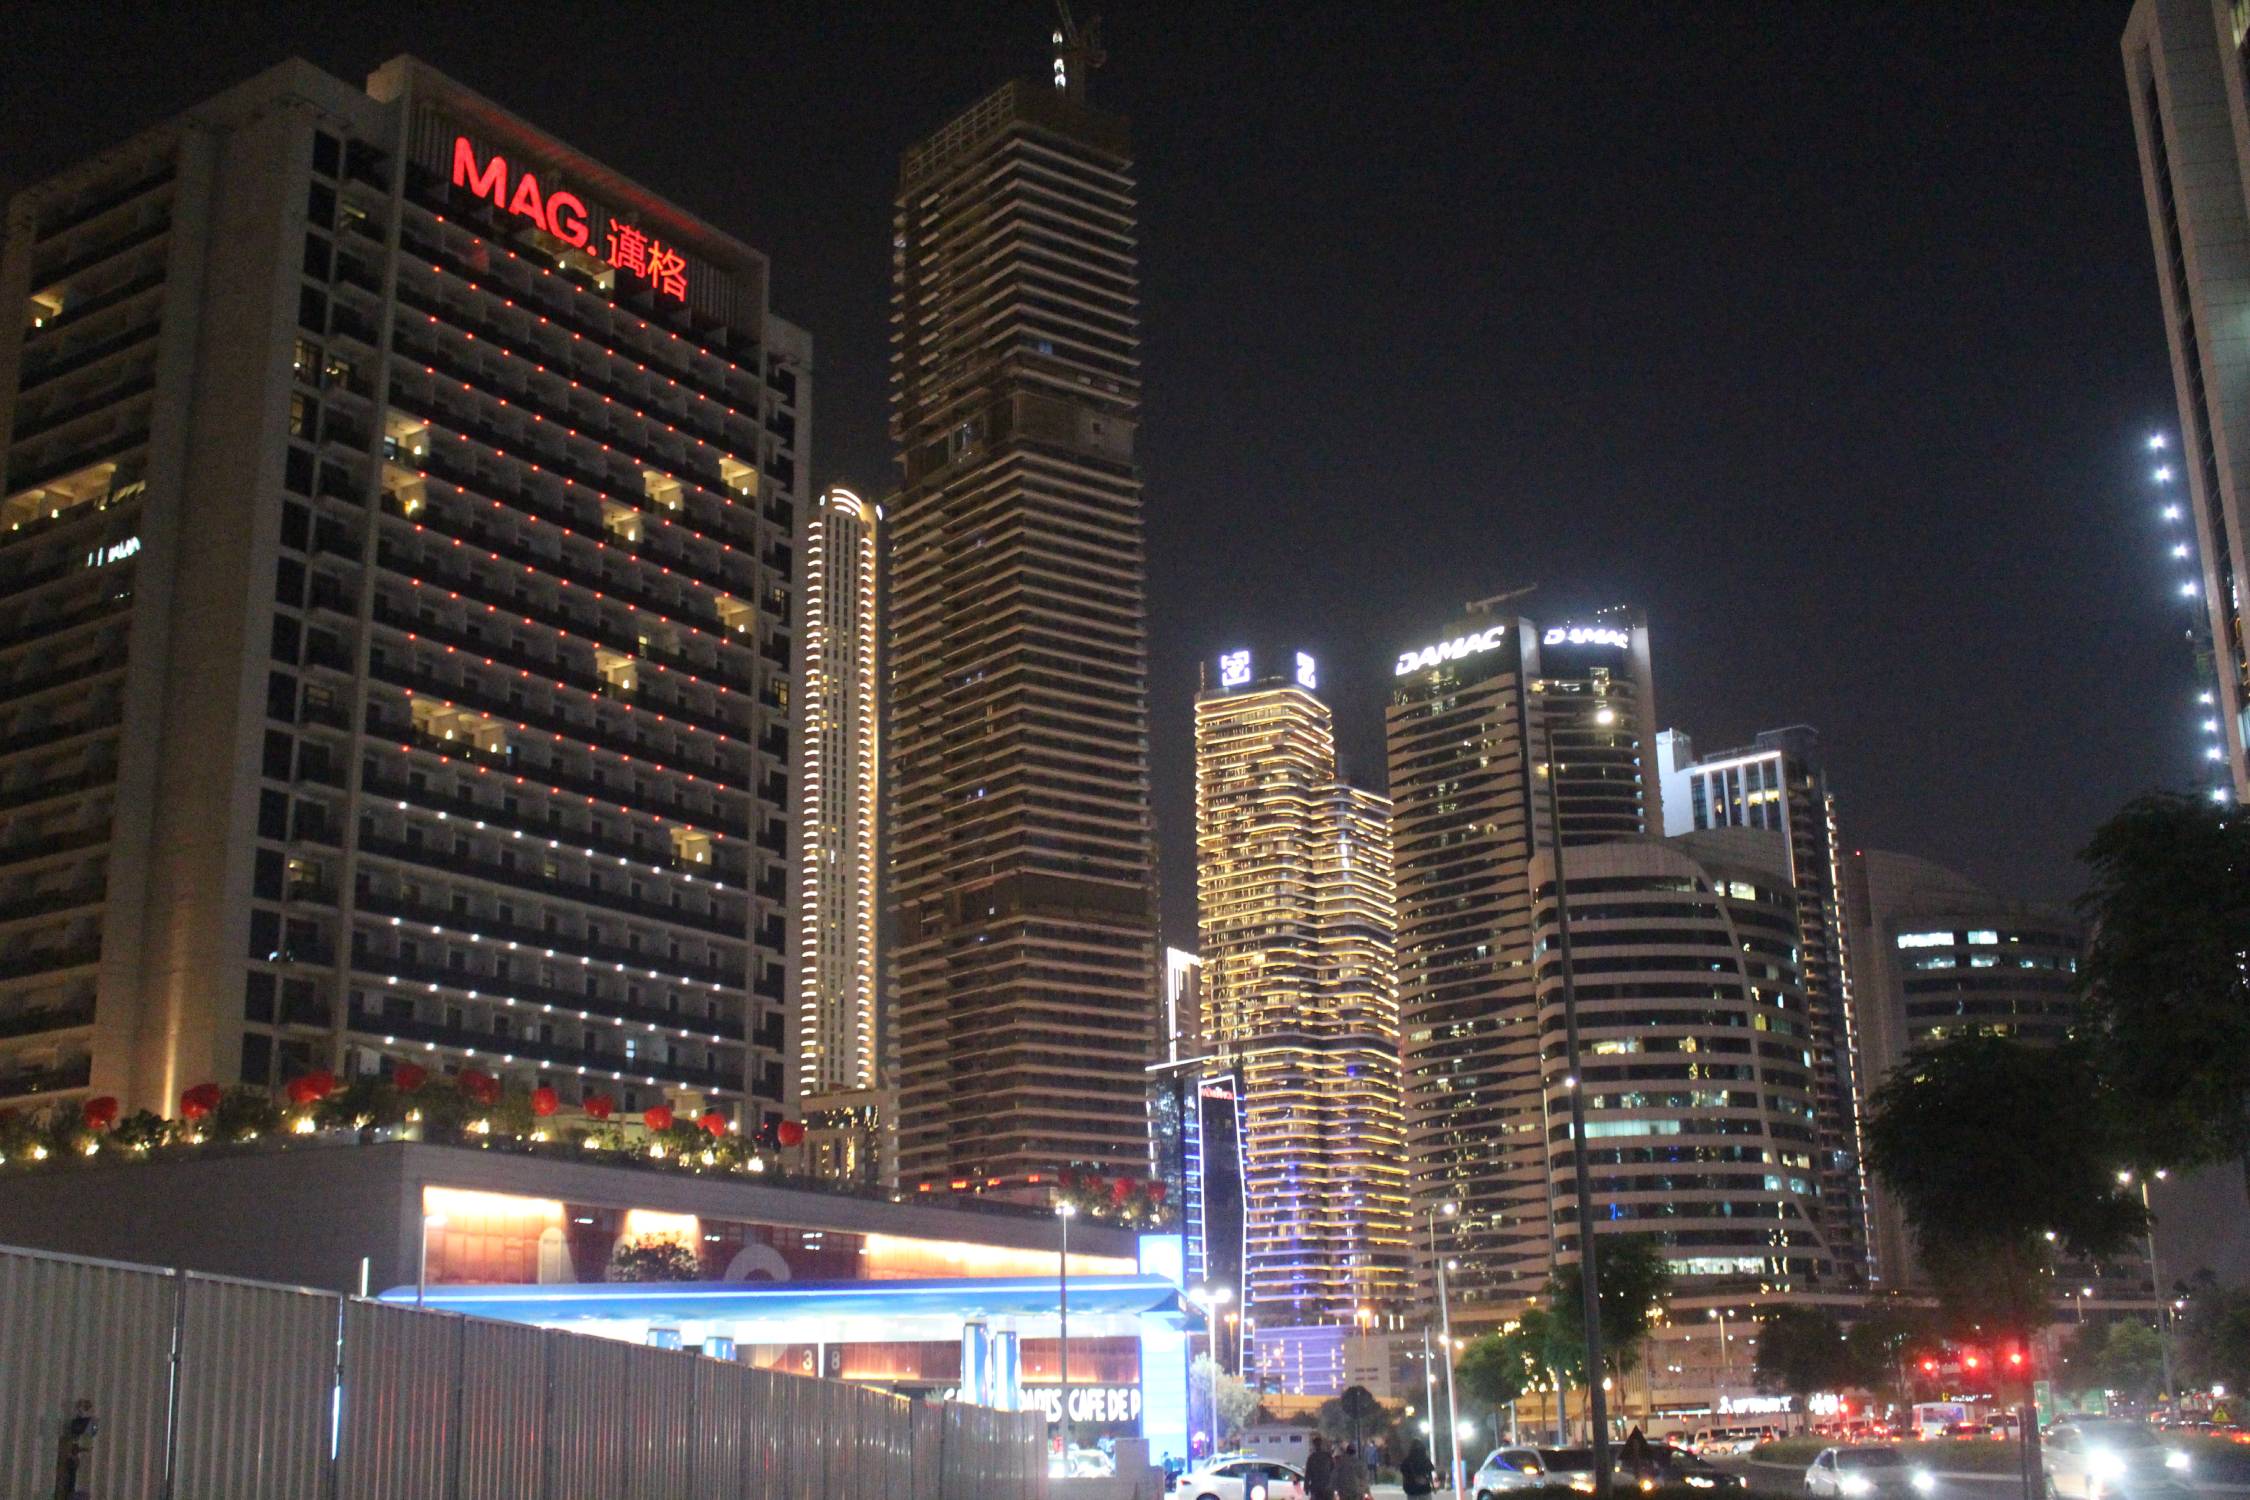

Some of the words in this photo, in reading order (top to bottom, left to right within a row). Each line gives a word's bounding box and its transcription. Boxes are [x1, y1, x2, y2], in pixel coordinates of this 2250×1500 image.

[1395, 625, 1505, 676] DAMAC
[1543, 627, 1629, 649] DAMAC
[1068, 1388, 1106, 1423] CAFE
[1107, 1388, 1129, 1422] DE
